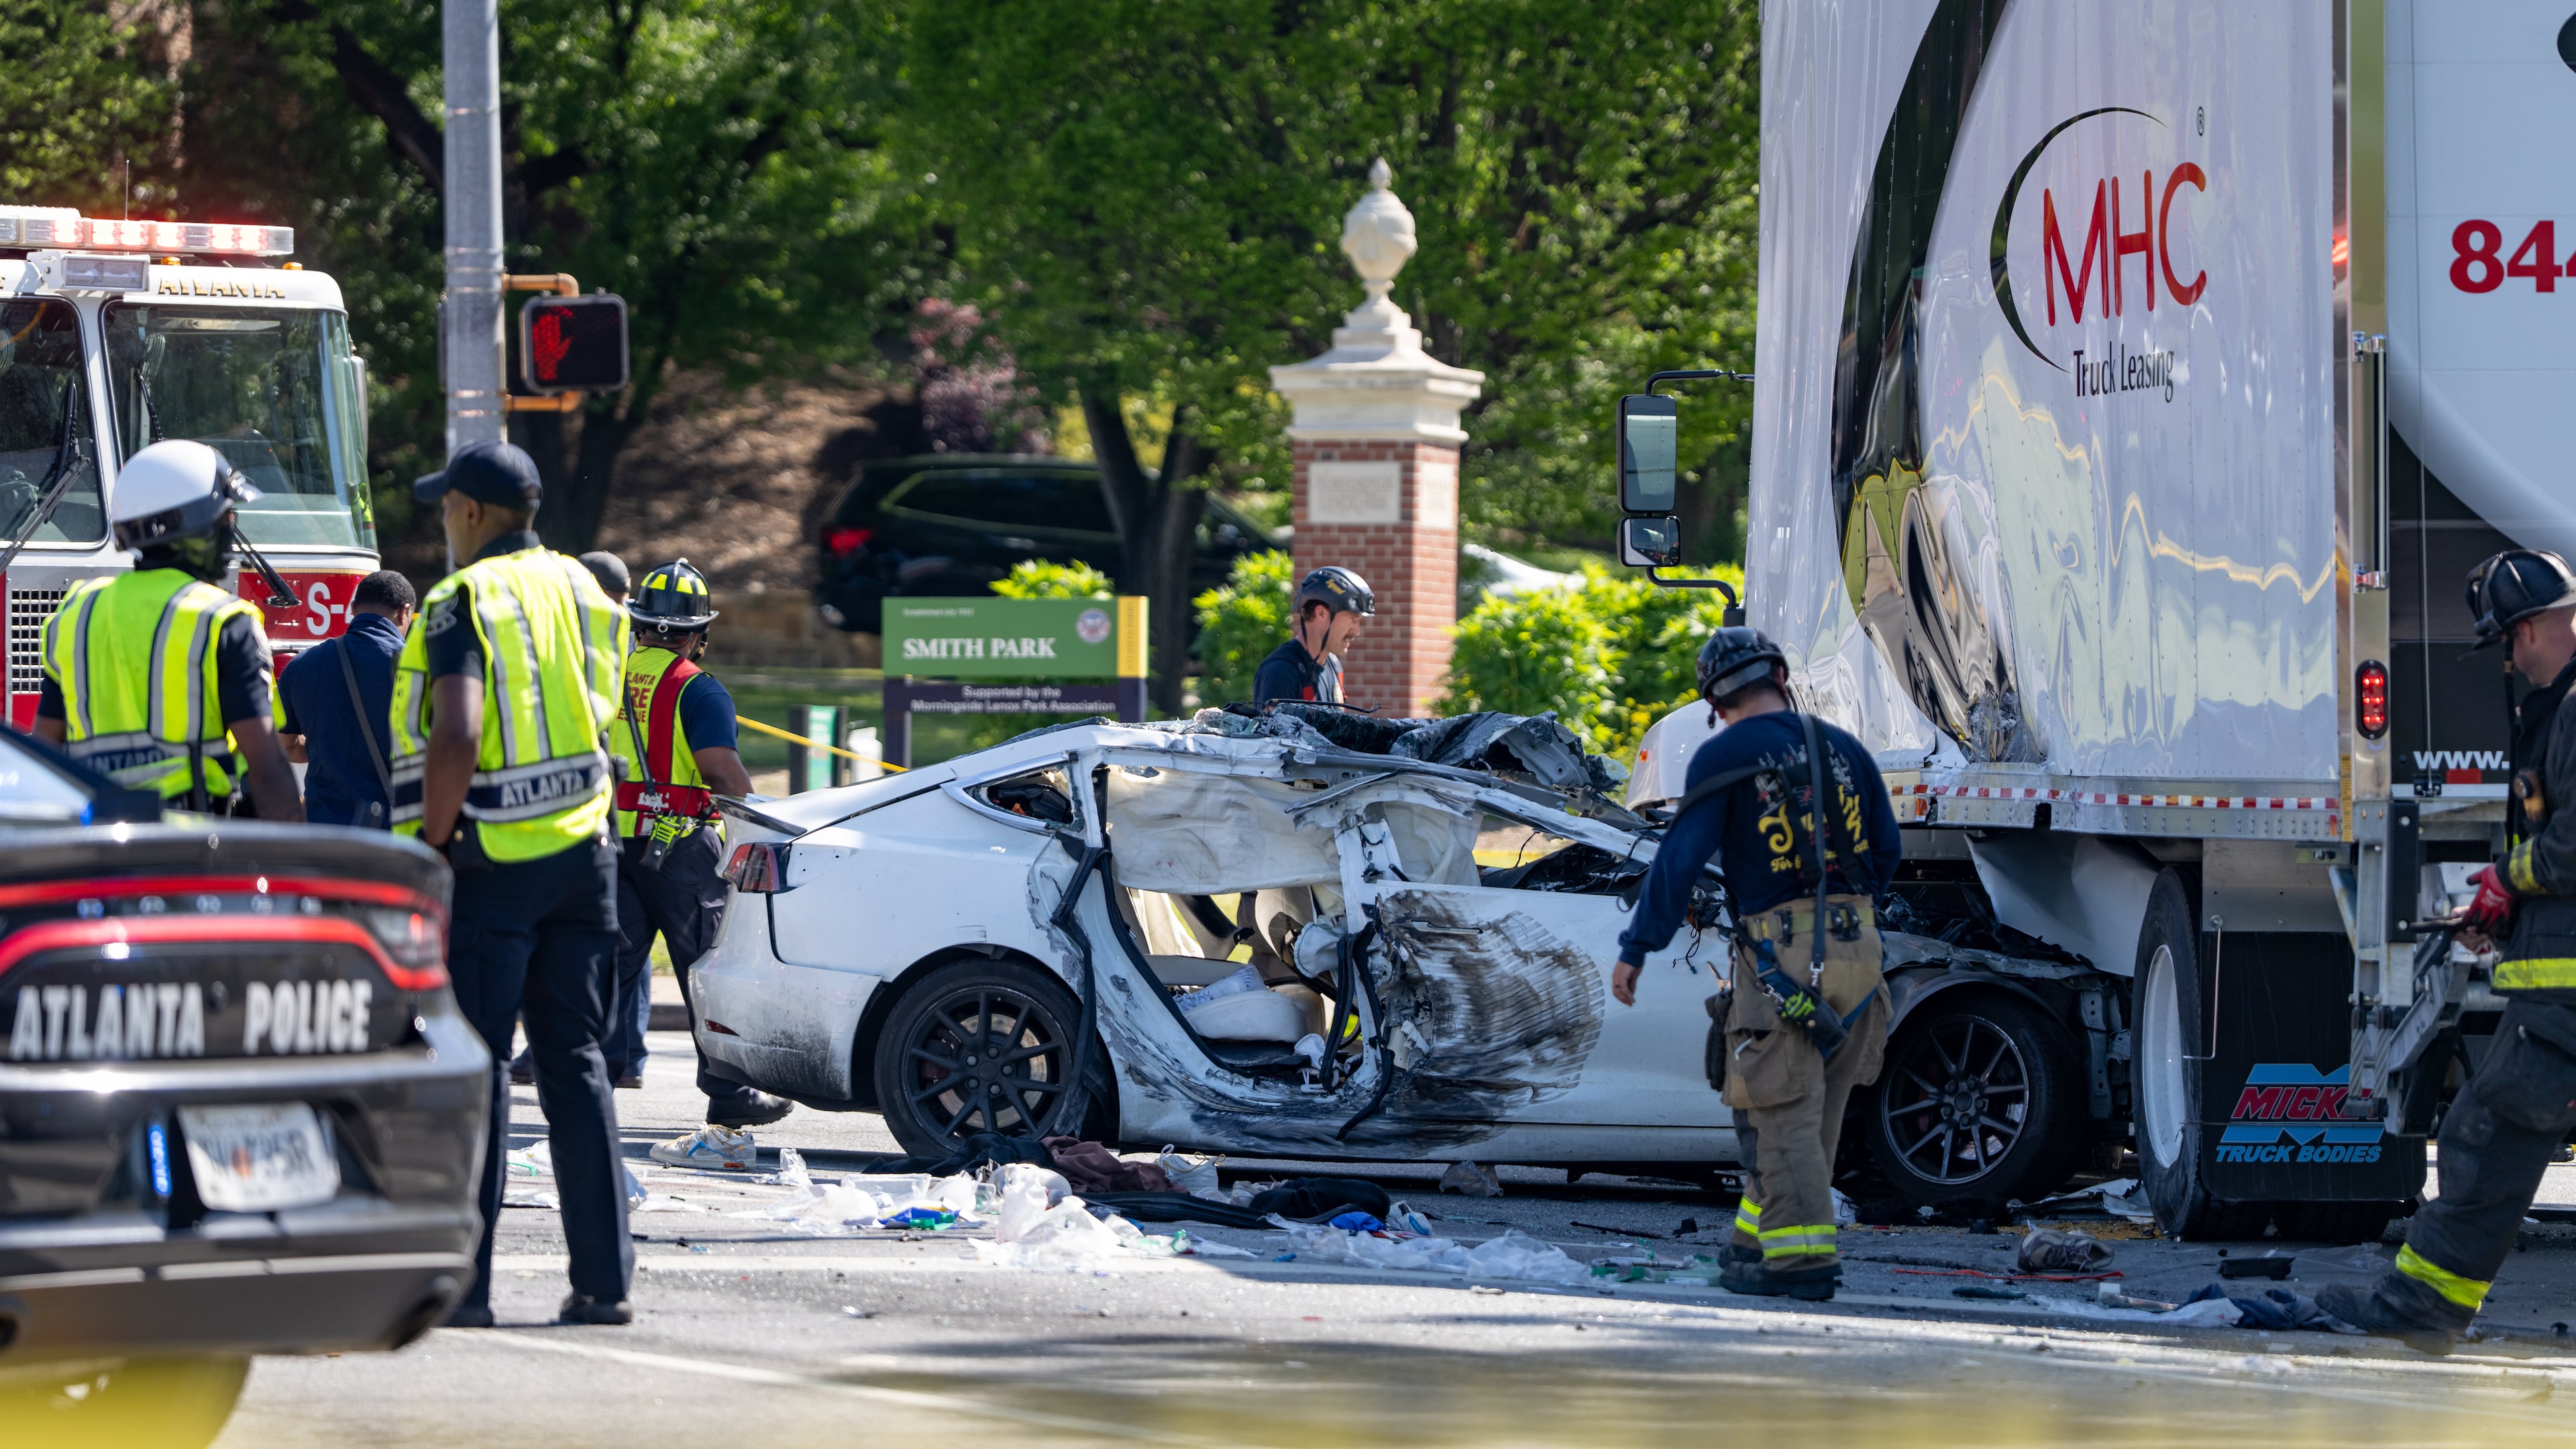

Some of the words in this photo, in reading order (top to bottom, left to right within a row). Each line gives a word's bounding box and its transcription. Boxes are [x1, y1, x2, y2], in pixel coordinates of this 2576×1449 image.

[2043, 162, 2206, 327] MHC
[2450, 219, 2576, 294] 84
[2074, 341, 2116, 396] Truck
[2121, 341, 2174, 402] Leasing
[903, 637, 985, 659] SMITH
[991, 637, 1057, 659] PARK
[910, 699, 983, 713] Morningside
[985, 700, 1020, 712] Lenox
[1022, 699, 1048, 711] Park
[1049, 700, 1116, 712] Association
[961, 685, 1023, 698] Supported
[1024, 686, 1040, 700] by
[1040, 686, 1061, 696] the
[2414, 751, 2510, 770] www.
[501, 769, 584, 807] ATLANTA
[9, 981, 205, 1061] ATLANTA
[243, 979, 373, 1055] POLICE
[2231, 1086, 2379, 1120] MICK
[2216, 1145, 2295, 1163] TRUCK
[2296, 1145, 2382, 1163] BODIES
